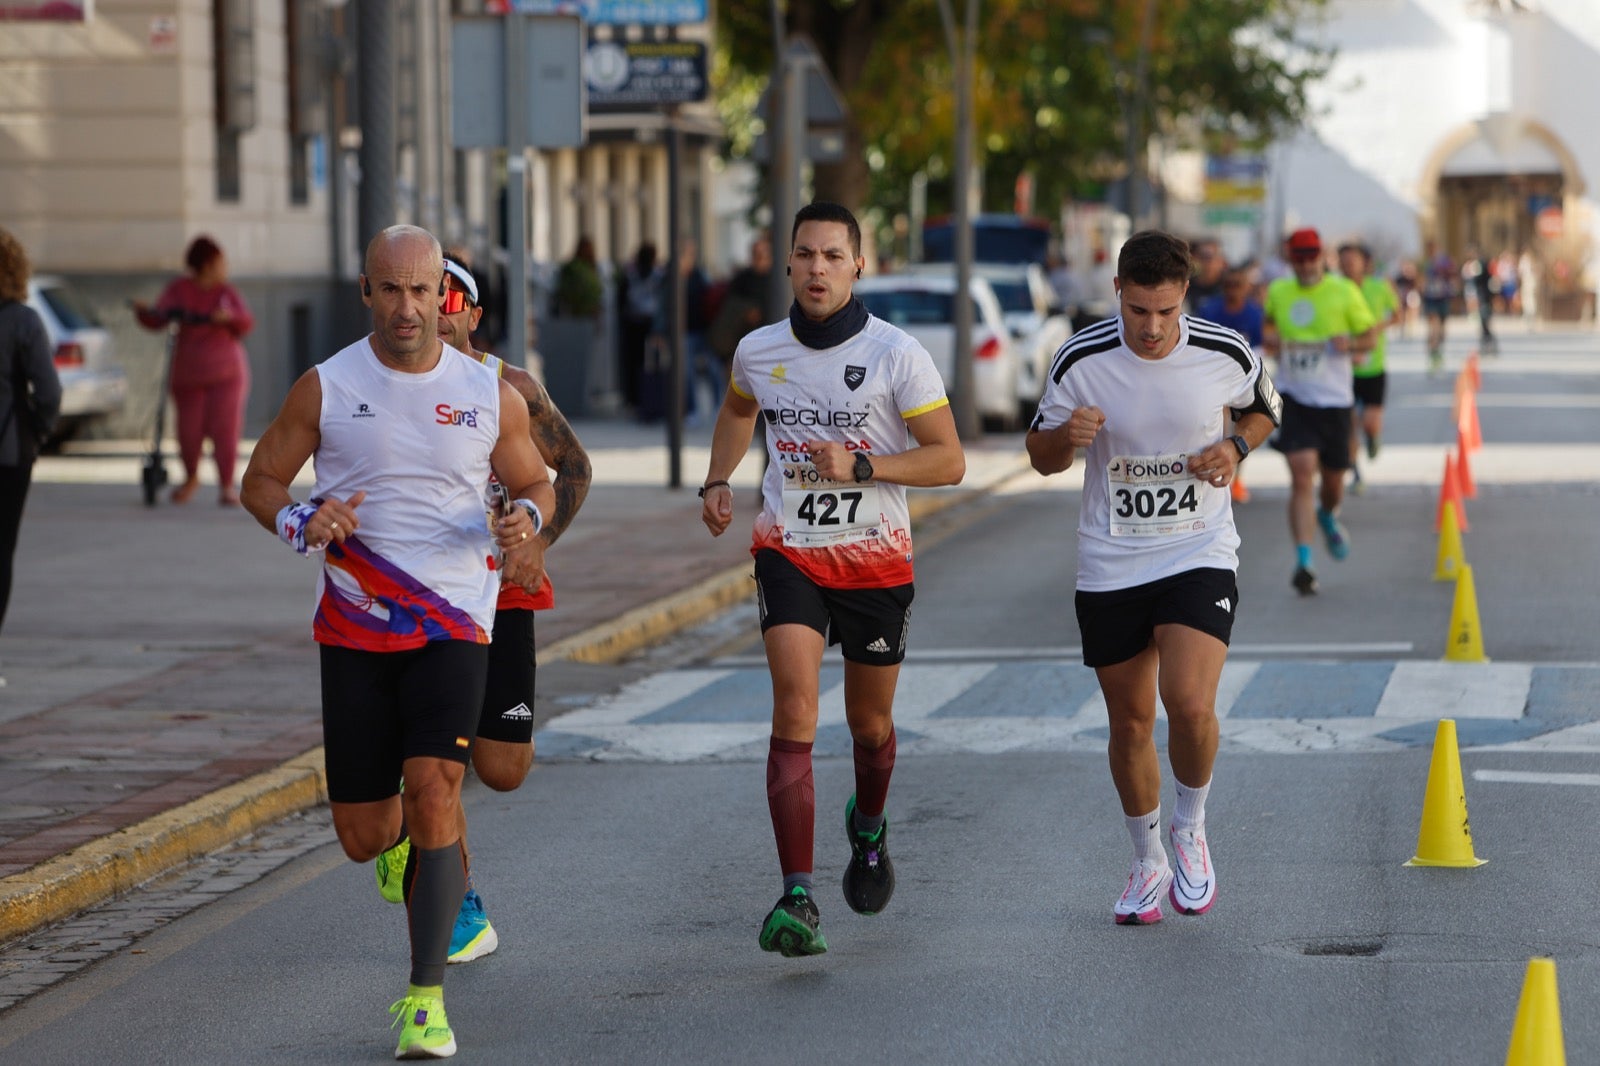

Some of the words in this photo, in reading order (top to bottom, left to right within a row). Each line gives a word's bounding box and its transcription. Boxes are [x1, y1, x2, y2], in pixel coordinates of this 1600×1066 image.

[1126, 461, 1184, 477] FONDO
[797, 491, 863, 526] 427
[1115, 484, 1198, 518] 3024
